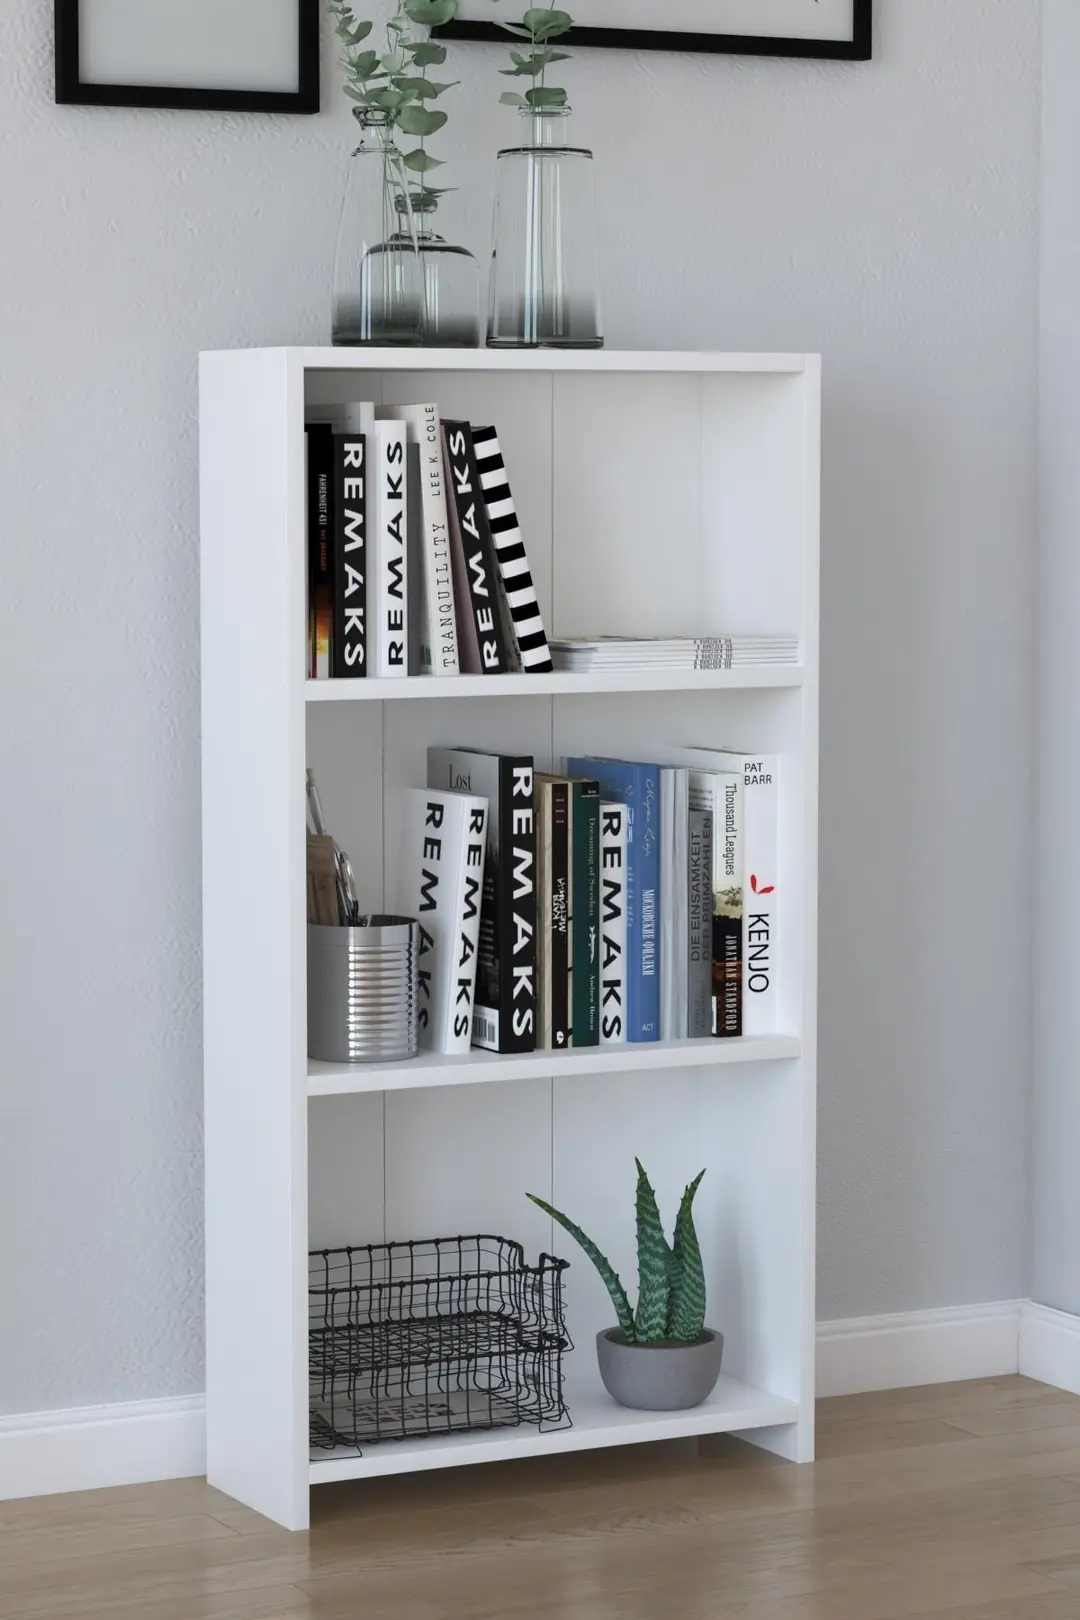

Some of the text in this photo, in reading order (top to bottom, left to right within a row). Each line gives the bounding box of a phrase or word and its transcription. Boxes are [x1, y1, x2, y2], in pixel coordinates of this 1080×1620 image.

[425, 406, 436, 442] COLE
[318, 474, 327, 525] FAHRENHEIT 451
[431, 471, 441, 496] LEE
[344, 442, 364, 666] REMAKS
[387, 441, 403, 665] REMAKS
[432, 523, 456, 667] TRANQUILITY
[450, 430, 499, 668] REMAKS
[449, 764, 473, 792] Lost
[744, 763, 763, 773] PAT
[744, 774, 772, 786] BARR
[588, 818, 596, 865] Dreaming
[588, 867, 595, 876] of
[723, 784, 737, 876] Thousand Leagues
[419, 802, 444, 1029] REMAKS
[453, 808, 484, 1038] REMAKS
[512, 766, 533, 1036] REMAKS
[602, 811, 621, 1039] REMAKS
[691, 832, 700, 962] DIE EINSAMKEIT
[703, 818, 711, 961] DER PRIMZAHLEN
[725, 935, 738, 978] JONATHAN
[748, 913, 770, 994] KENJO
